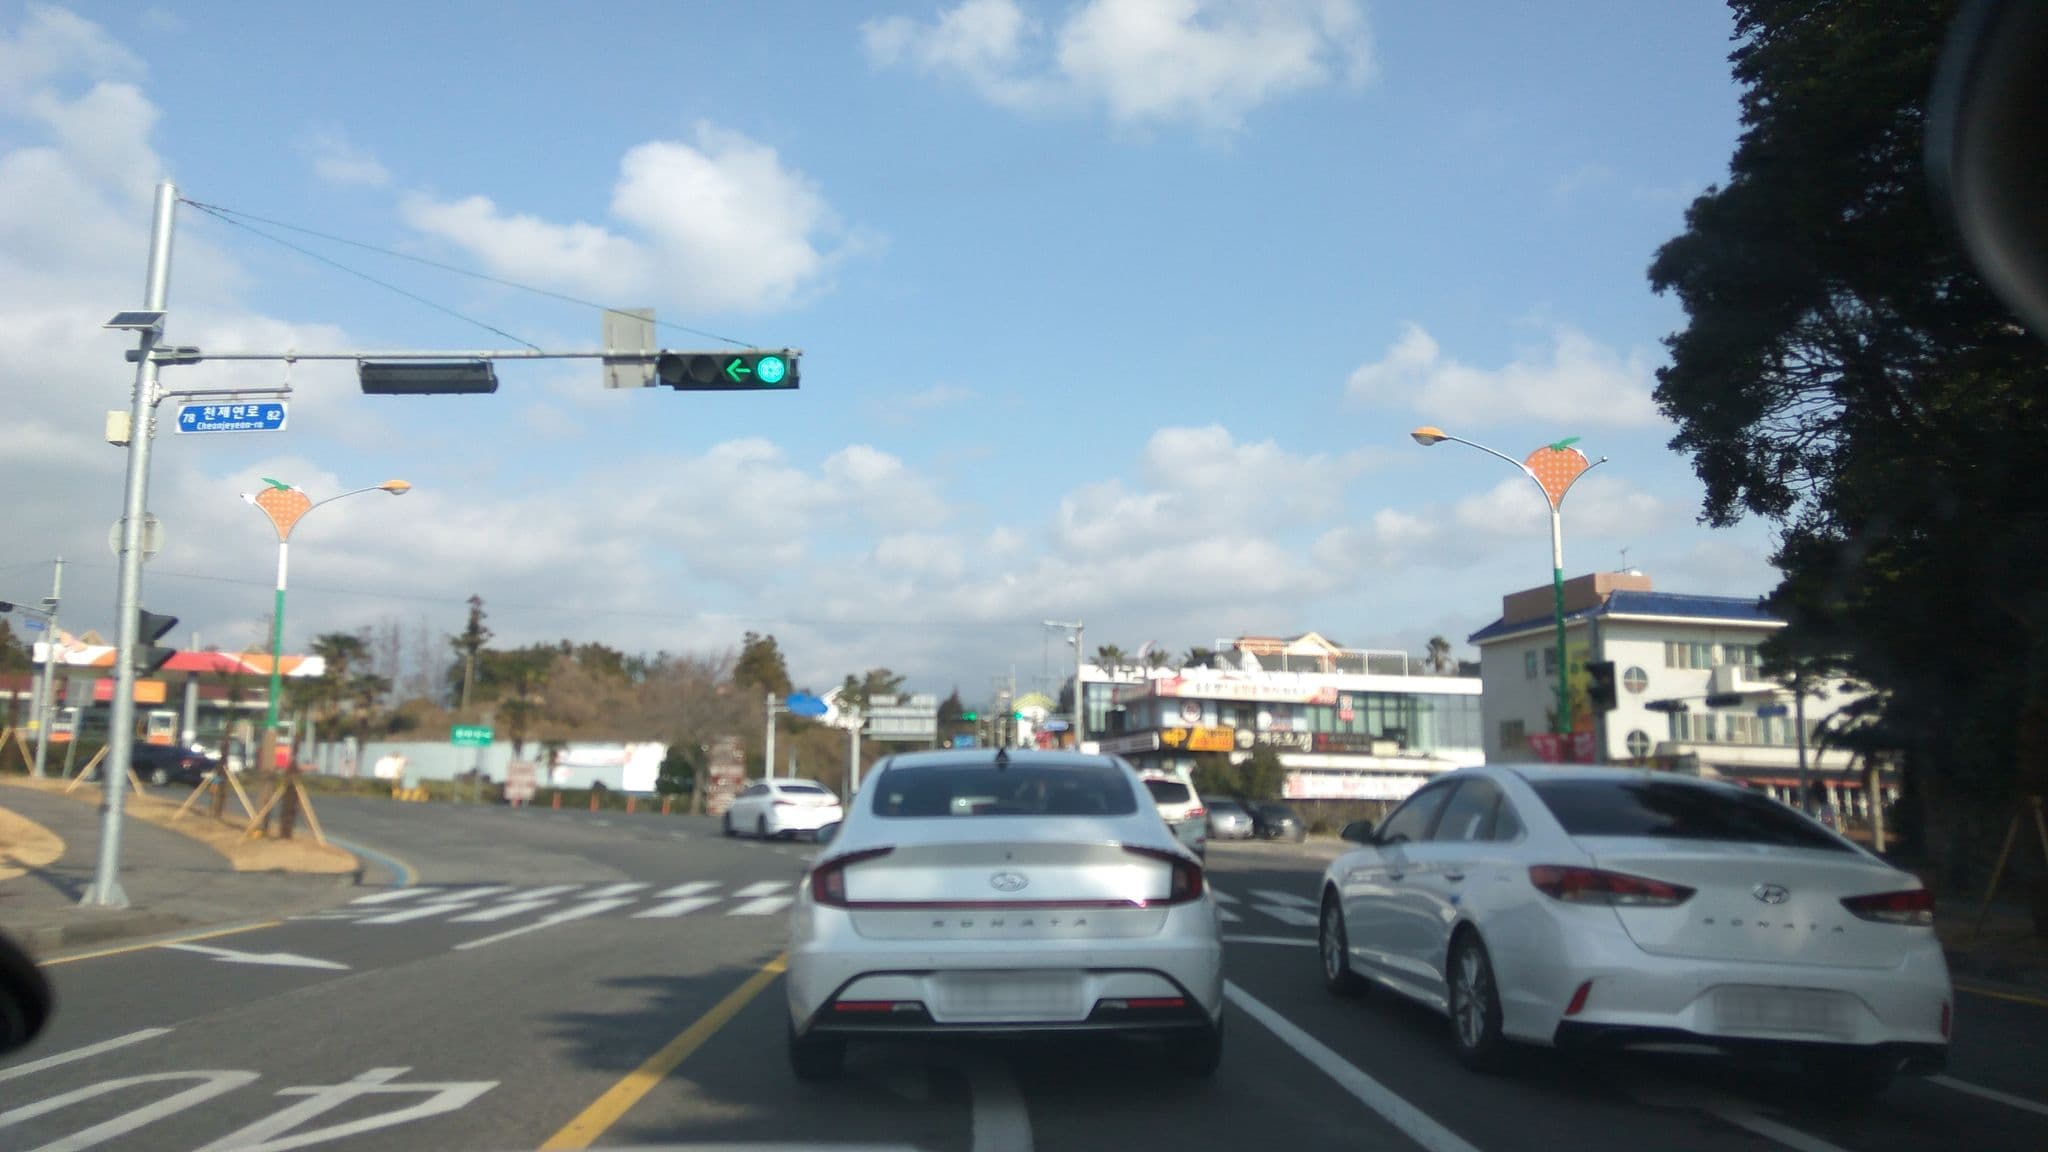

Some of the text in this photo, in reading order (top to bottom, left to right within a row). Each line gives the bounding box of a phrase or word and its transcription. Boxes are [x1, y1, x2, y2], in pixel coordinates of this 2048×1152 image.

[183, 413, 196, 423] 78
[203, 405, 260, 420] 천제연로
[266, 410, 281, 421] 82
[932, 918, 1087, 928] SONATA
[1703, 918, 1844, 932] SONATA
